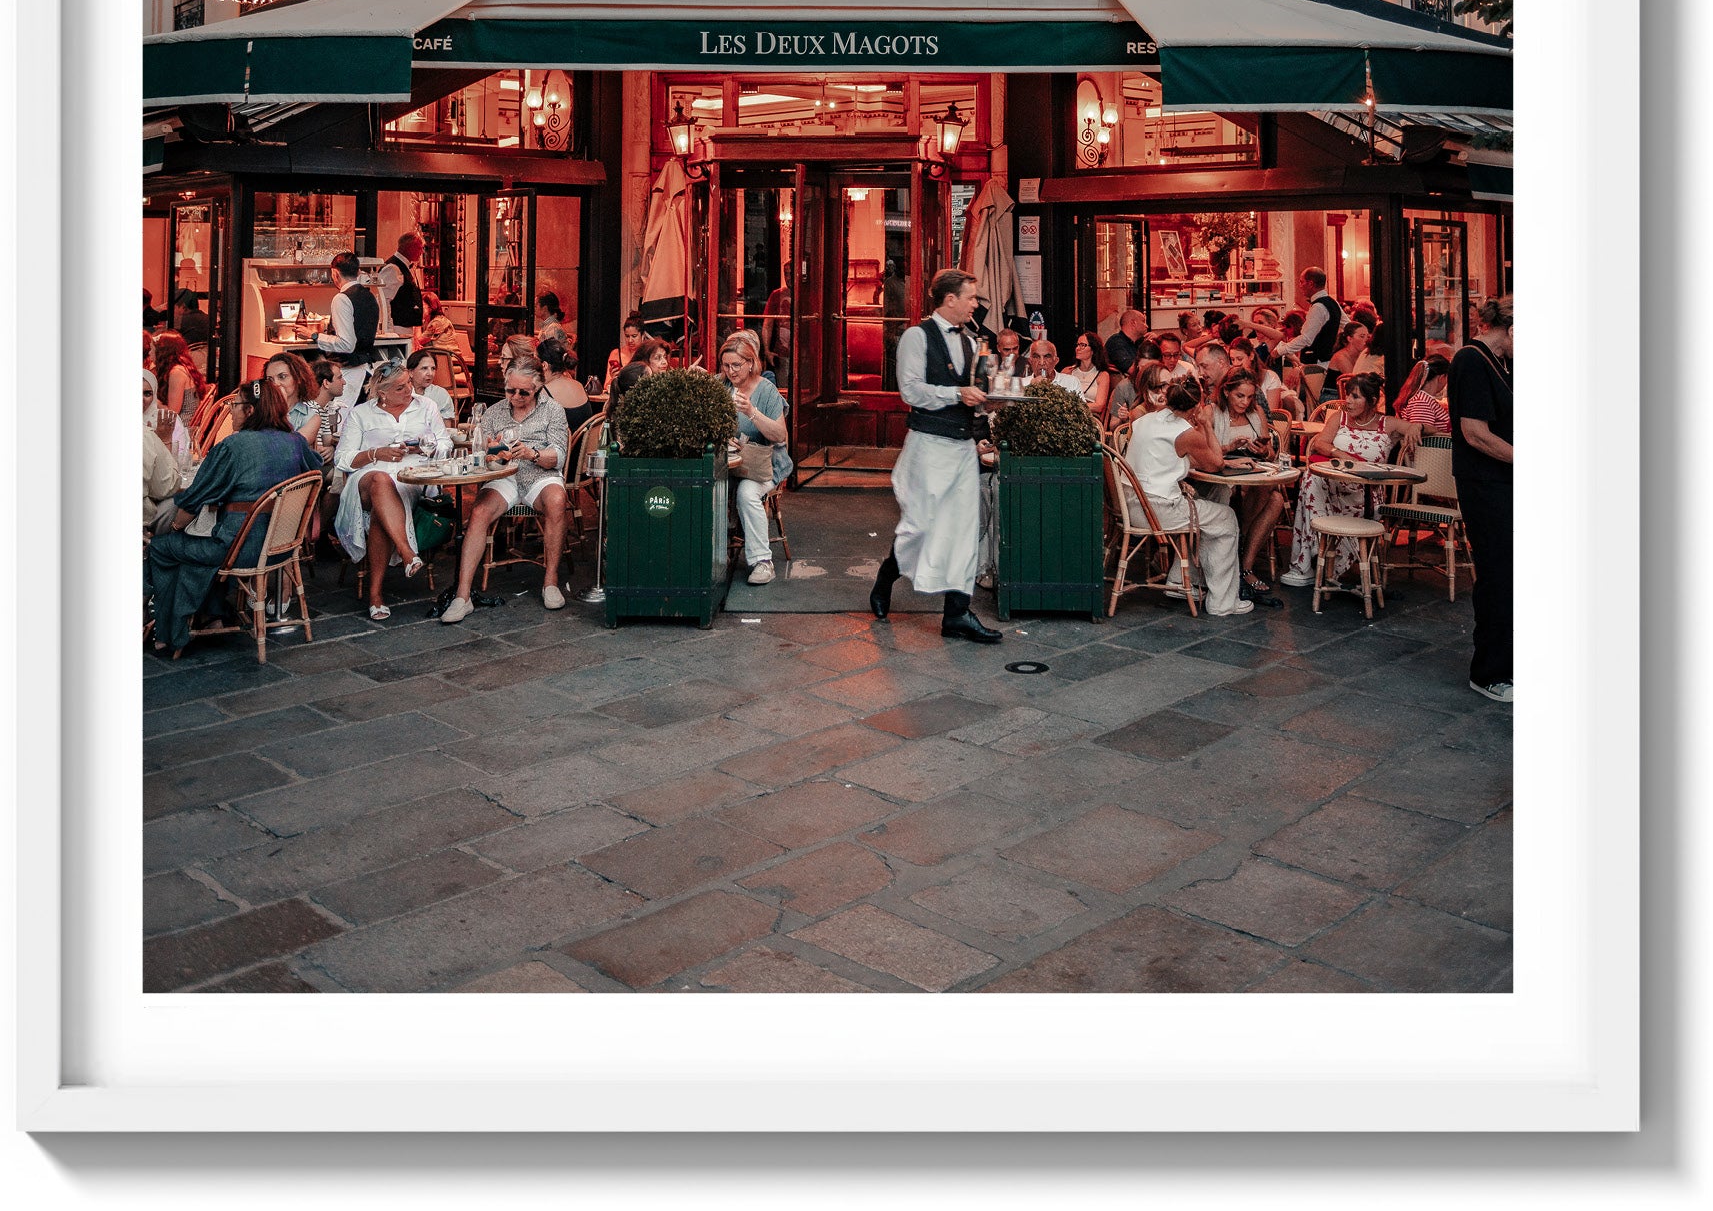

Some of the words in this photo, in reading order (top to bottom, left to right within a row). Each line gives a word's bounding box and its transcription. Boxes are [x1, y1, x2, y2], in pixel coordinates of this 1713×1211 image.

[412, 34, 453, 50] CAFÉ
[699, 30, 747, 55] LES
[754, 30, 826, 55] DEUX
[831, 30, 939, 56] MAGOTS
[1126, 41, 1157, 55] RES
